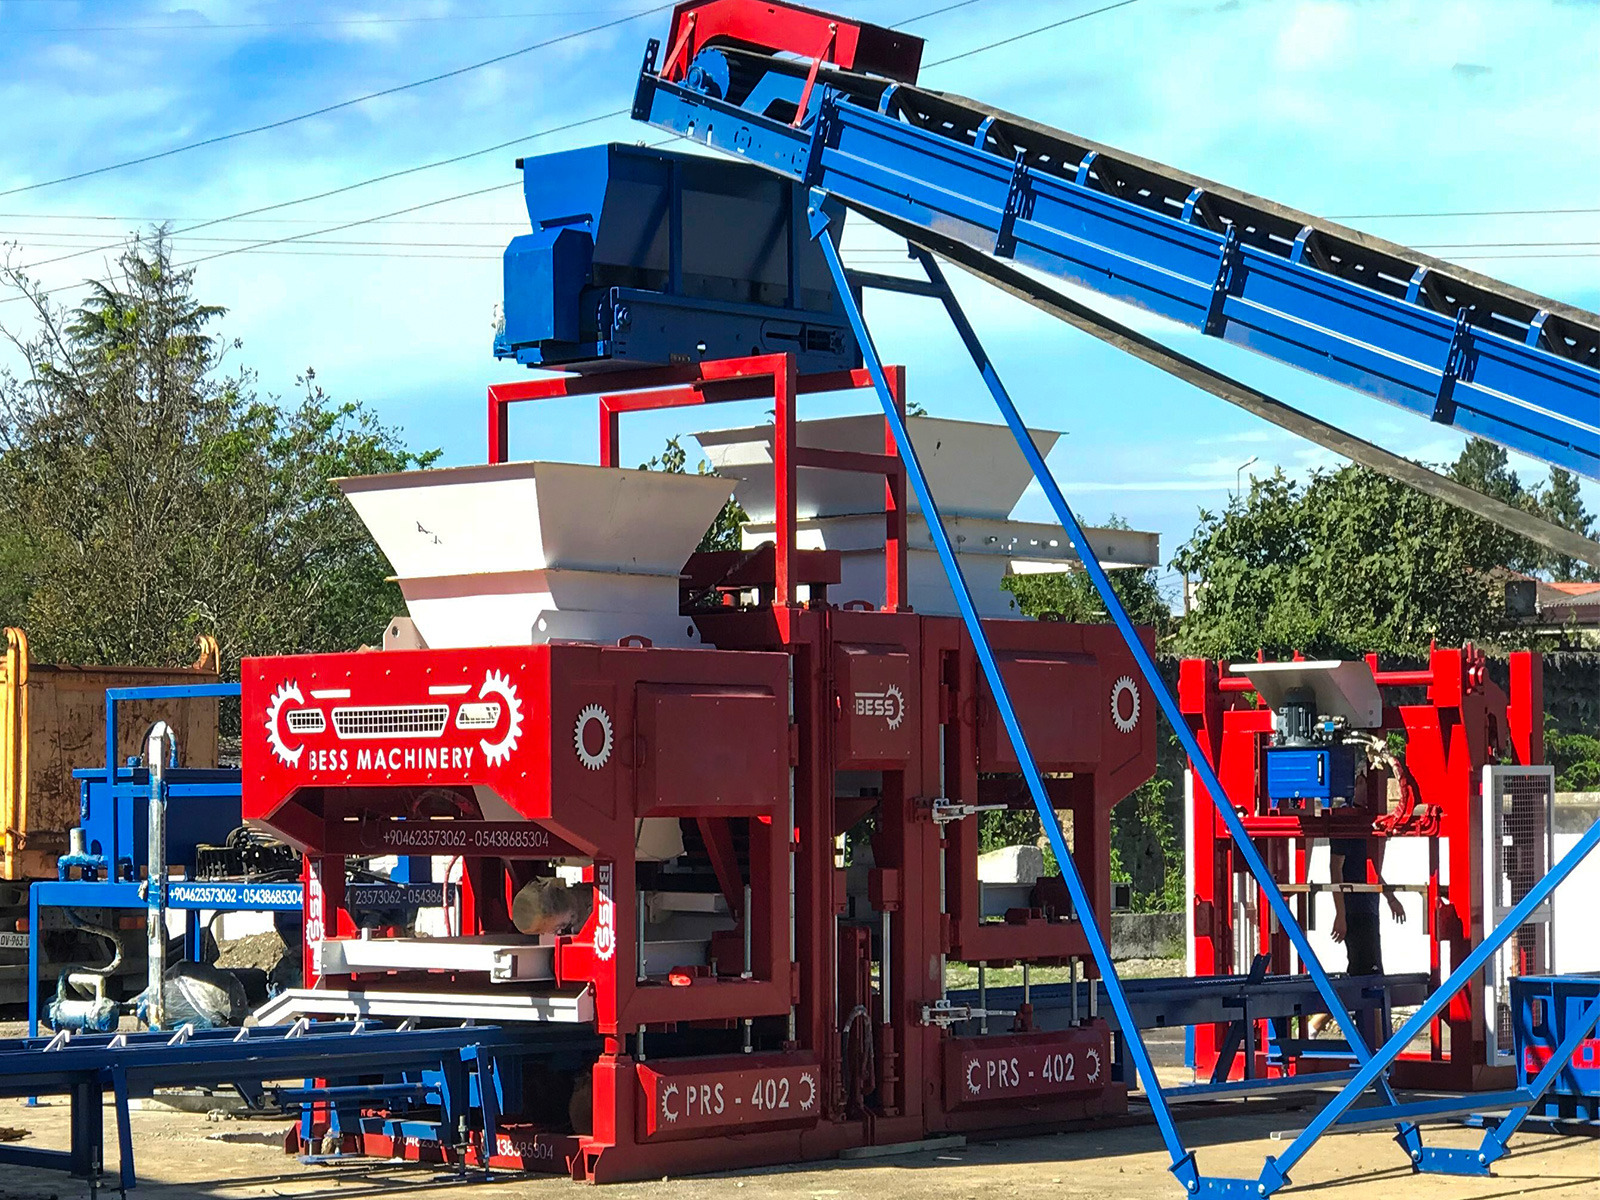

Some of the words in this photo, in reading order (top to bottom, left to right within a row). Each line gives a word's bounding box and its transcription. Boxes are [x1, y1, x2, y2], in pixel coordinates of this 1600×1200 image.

[855, 699, 894, 716] BESS
[309, 749, 349, 771] BESS
[356, 747, 474, 770] MACHINERY
[383, 829, 466, 846] +904623573062
[475, 830, 549, 848] 05438685304
[169, 887, 237, 903] +904623573062
[598, 865, 612, 949] BESS
[986, 1057, 1020, 1089] PRS
[1042, 1052, 1075, 1083] 402
[686, 1082, 724, 1117] PRS
[751, 1077, 790, 1111] 402
